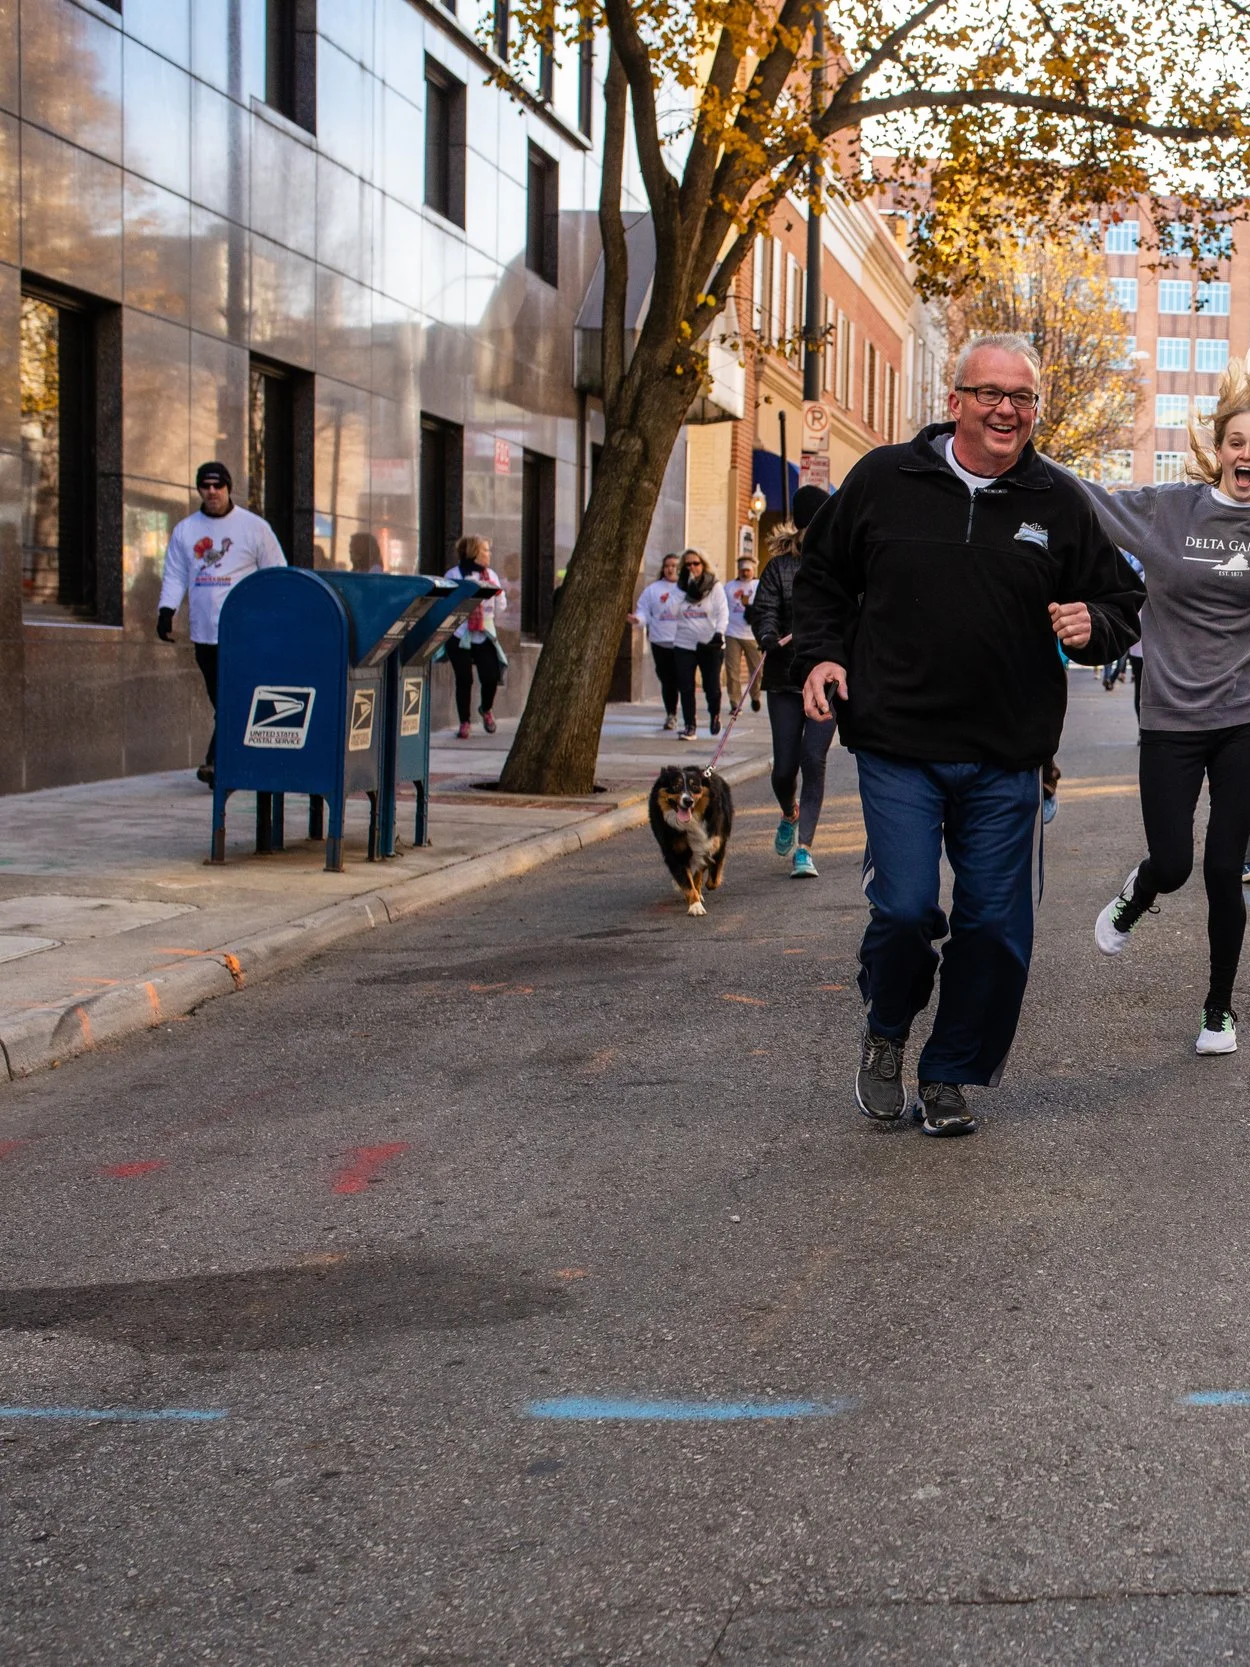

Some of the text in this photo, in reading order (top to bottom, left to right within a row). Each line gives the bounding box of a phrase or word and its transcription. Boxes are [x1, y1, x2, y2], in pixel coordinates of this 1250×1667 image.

[1185, 536, 1225, 550] DELTA
[249, 730, 275, 738] UNITED
[274, 737, 301, 745] SERVICE
